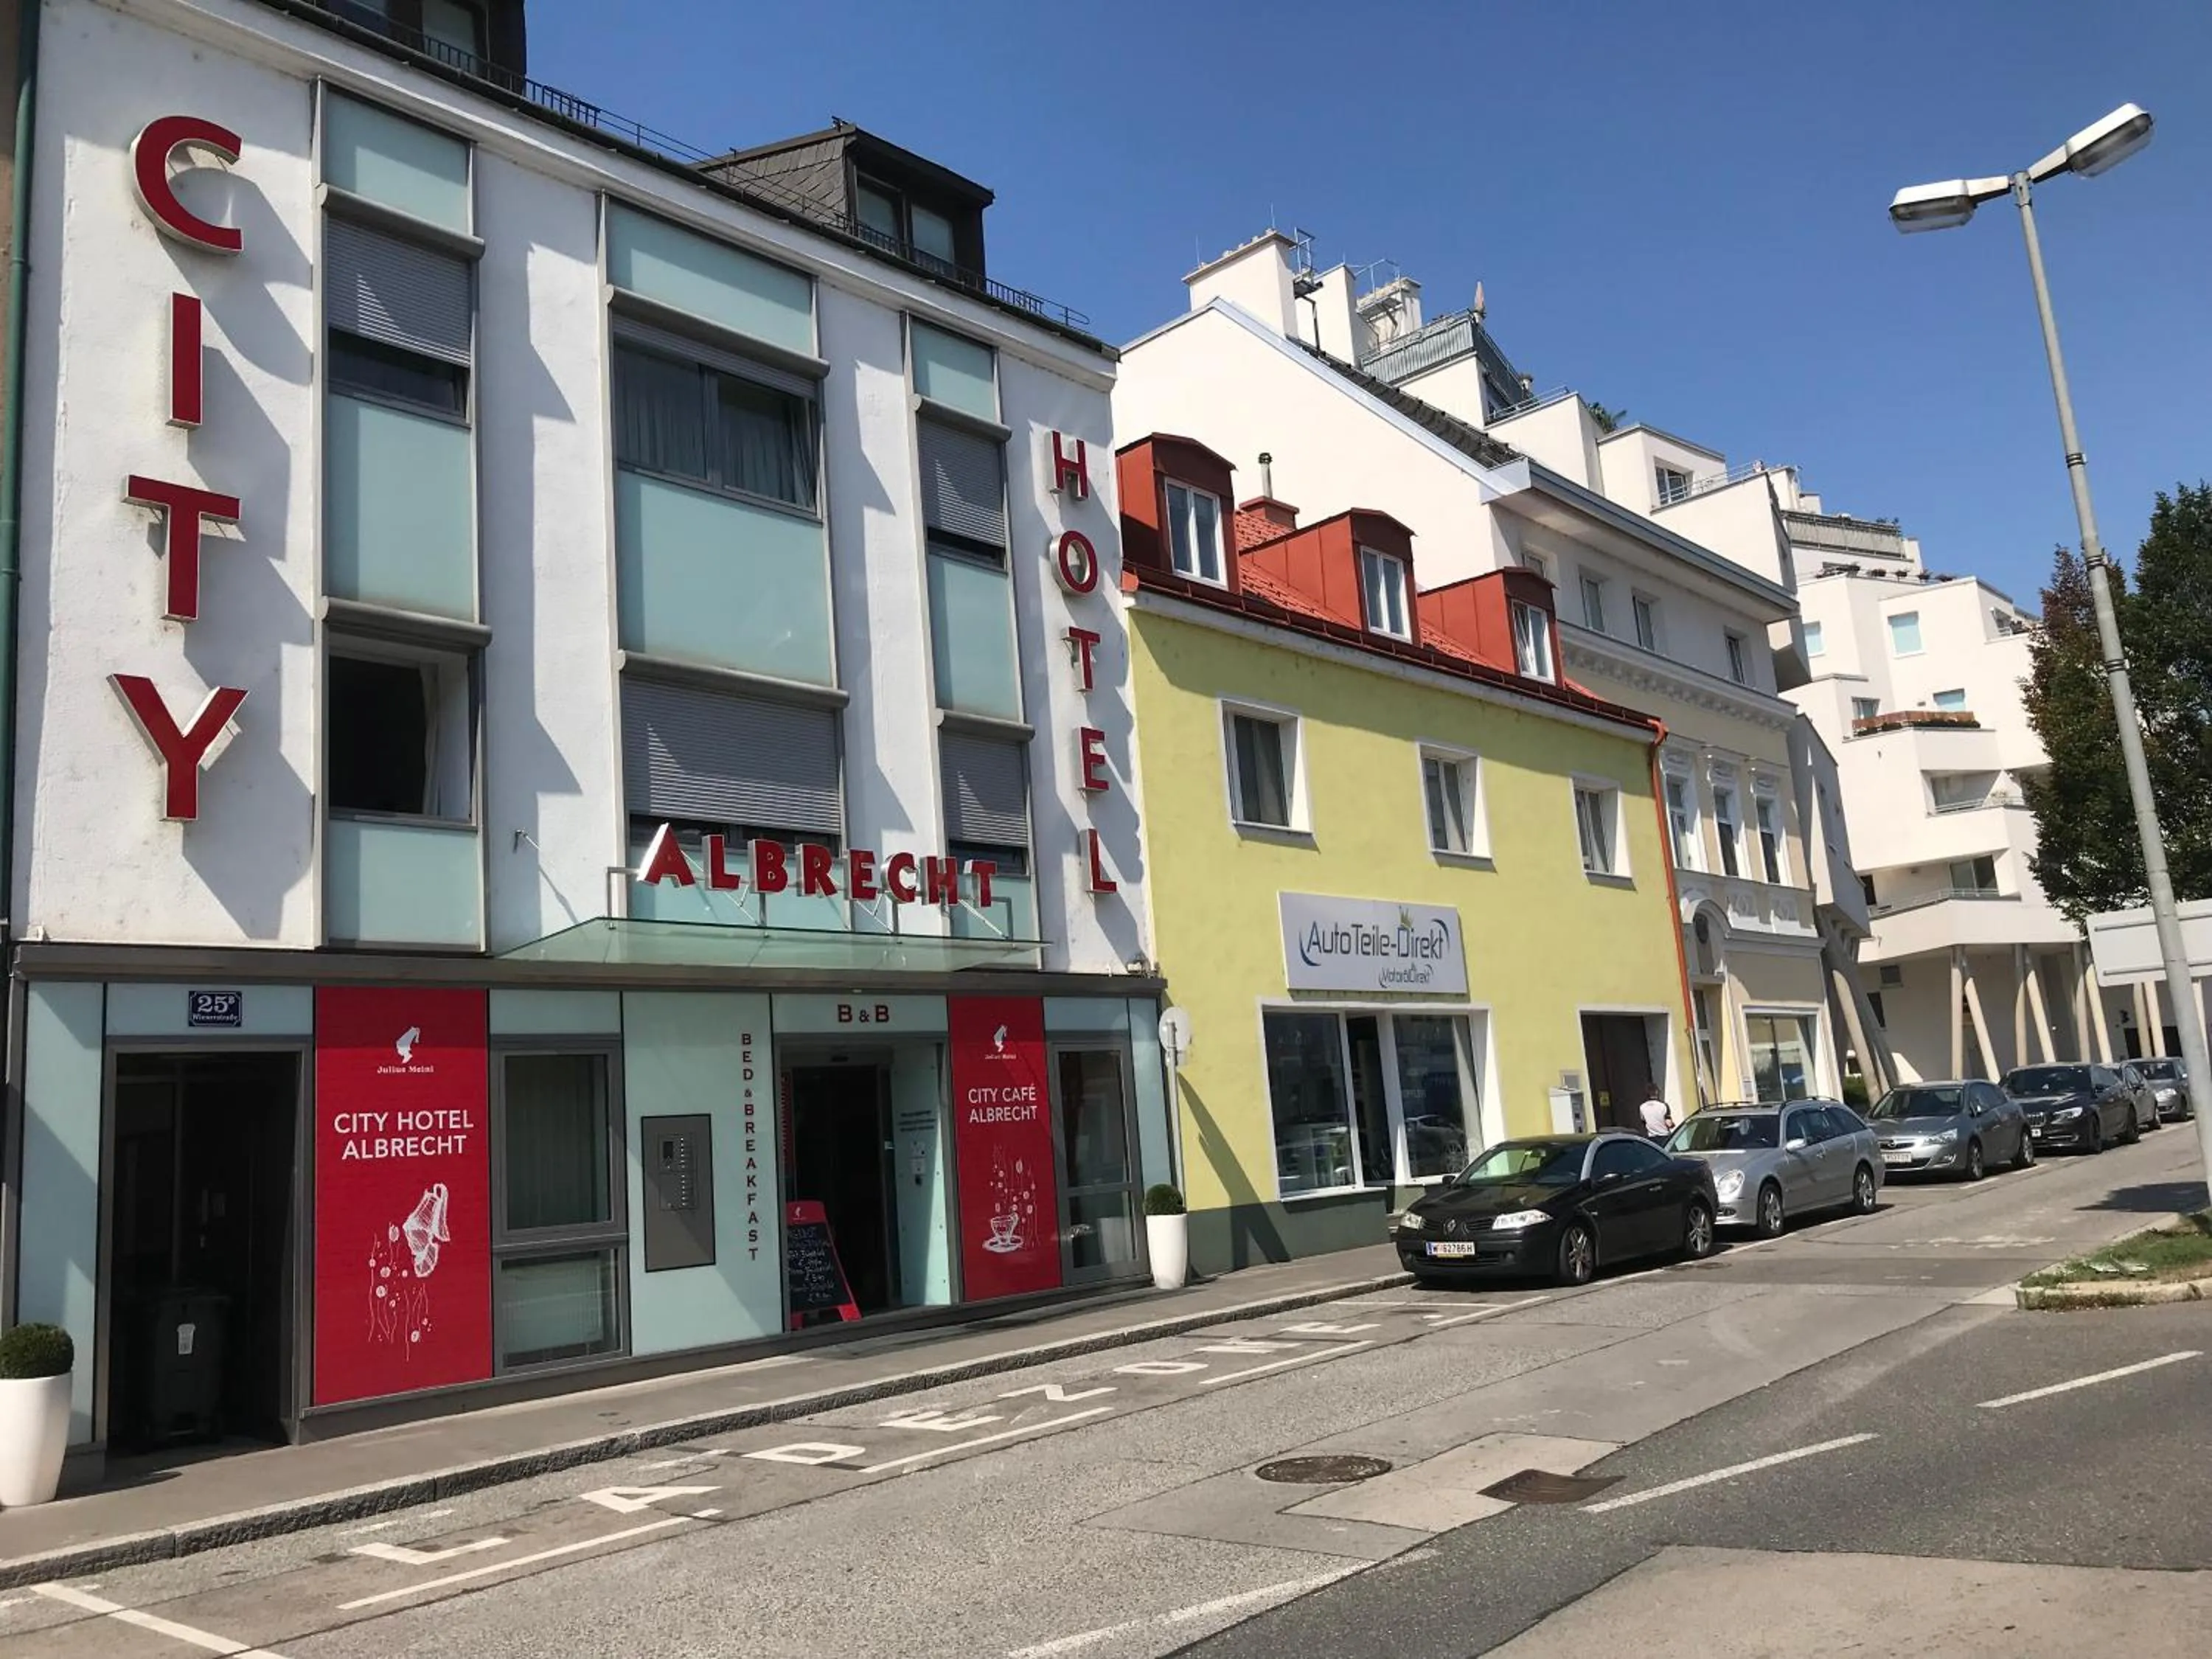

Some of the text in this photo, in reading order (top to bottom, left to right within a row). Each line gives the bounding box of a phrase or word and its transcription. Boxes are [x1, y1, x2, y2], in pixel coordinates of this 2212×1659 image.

[105, 116, 248, 821] CITY
[1048, 431, 1117, 893] HOTEL
[636, 822, 998, 908] ALBRECHT
[377, 1065, 406, 1074] Julius
[968, 1082, 1037, 1104] CITY CAFÉ
[334, 1110, 474, 1133] CITY HOTEL
[969, 1105, 1038, 1123] ALBRECHT
[341, 1135, 467, 1160] ALBRECHT
